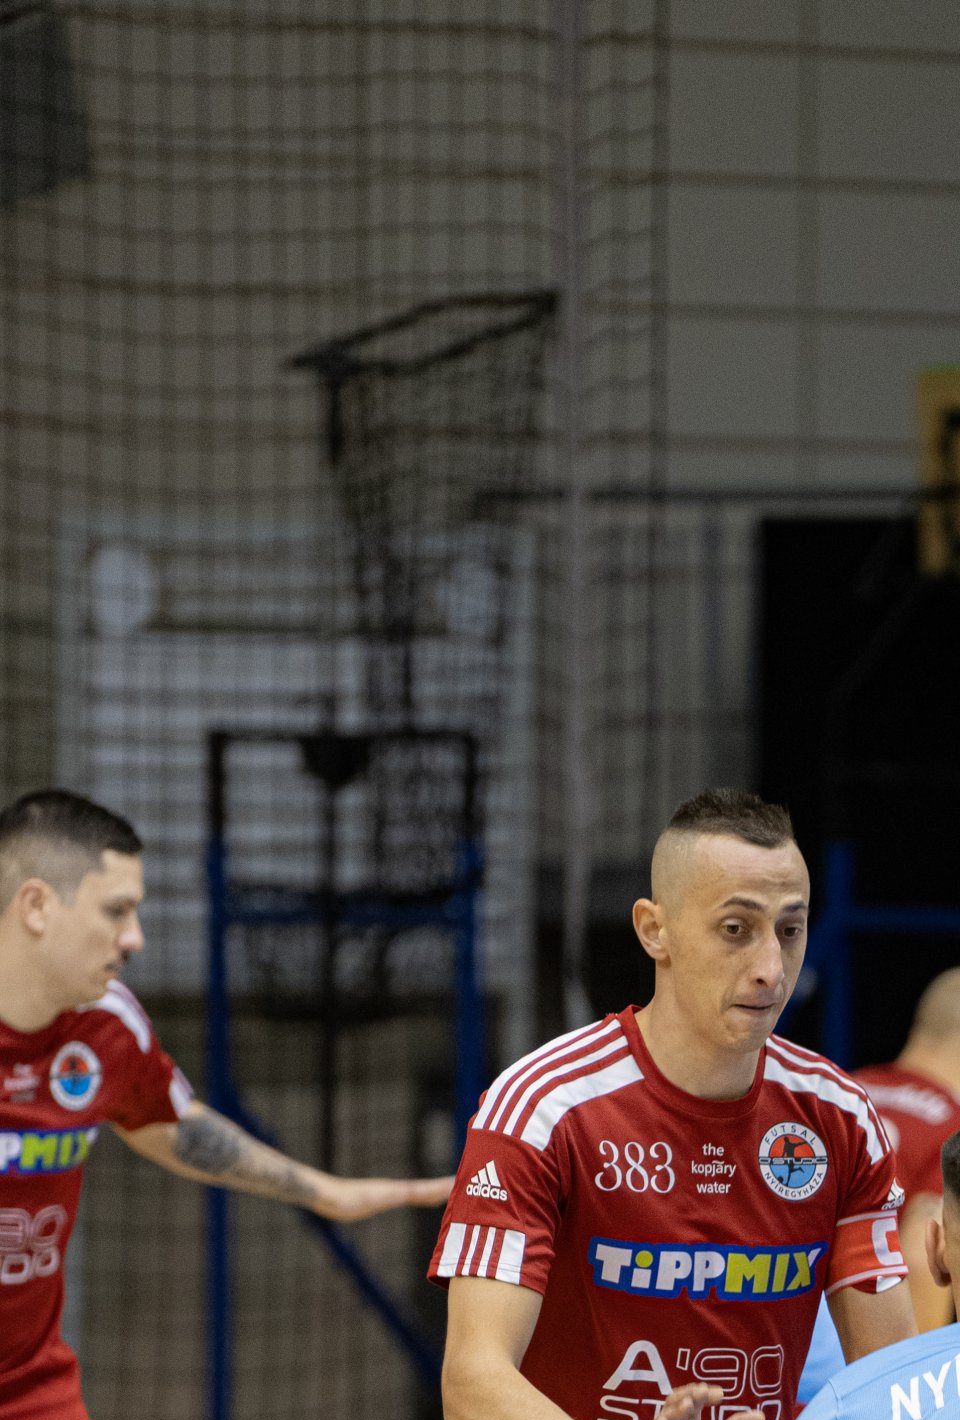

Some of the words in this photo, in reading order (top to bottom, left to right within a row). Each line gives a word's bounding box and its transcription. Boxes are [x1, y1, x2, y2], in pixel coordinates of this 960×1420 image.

[764, 1124, 817, 1145] FUTSAL
[702, 1143, 725, 1157] the
[594, 1140, 675, 1194] 383
[466, 1181, 508, 1202] adidas
[696, 1182, 732, 1194] water
[872, 1217, 904, 1267] C
